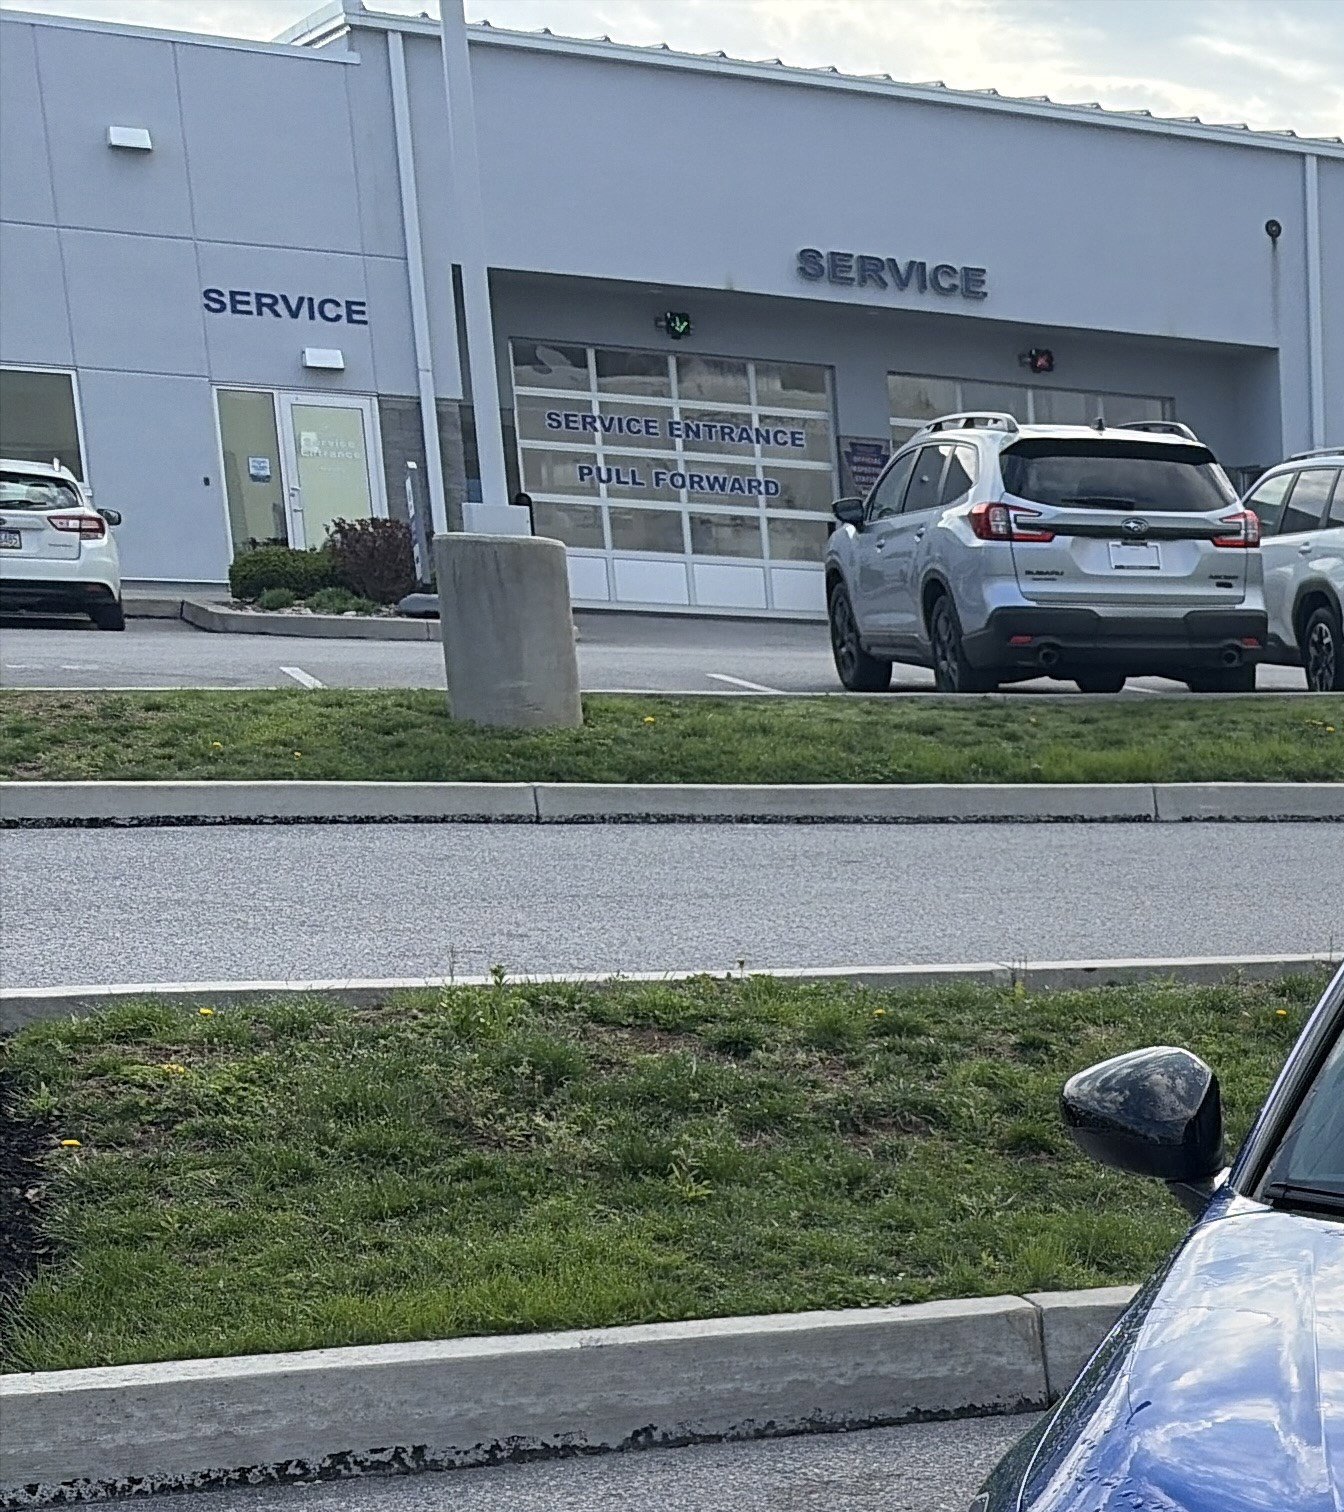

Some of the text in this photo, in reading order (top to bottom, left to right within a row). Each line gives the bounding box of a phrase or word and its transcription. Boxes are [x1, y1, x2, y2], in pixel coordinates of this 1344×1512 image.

[796, 248, 988, 300] SERVICE
[202, 288, 369, 326] SERVICE
[545, 411, 805, 448] SERVICE ENTRANCE
[577, 465, 781, 497] PULL FORWARD
